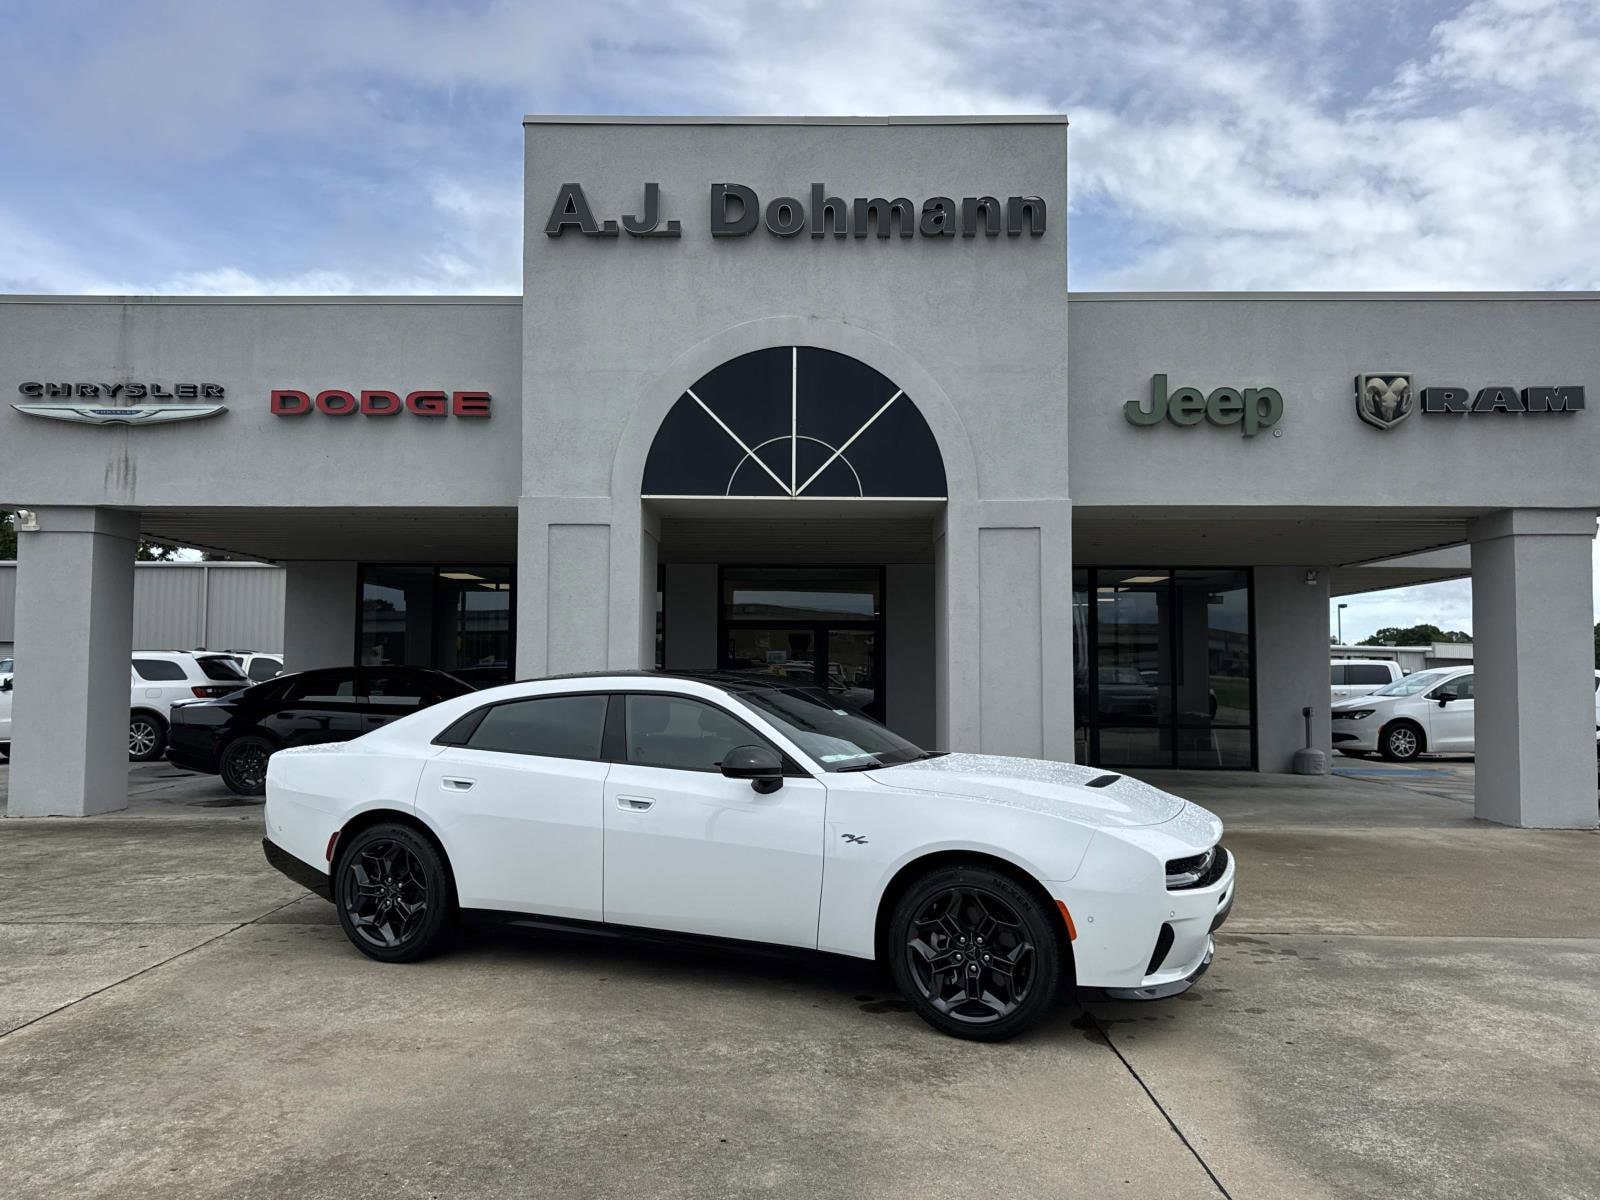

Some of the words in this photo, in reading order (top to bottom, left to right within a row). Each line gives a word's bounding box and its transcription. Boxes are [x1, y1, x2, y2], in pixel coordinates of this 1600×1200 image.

[545, 182, 681, 239] A.J.
[711, 183, 1047, 239] Dohmann
[18, 382, 225, 398] CHRYSLER
[271, 390, 492, 418] DODGE
[1421, 386, 1586, 416] RAM
[1124, 374, 1283, 438] Jeep
